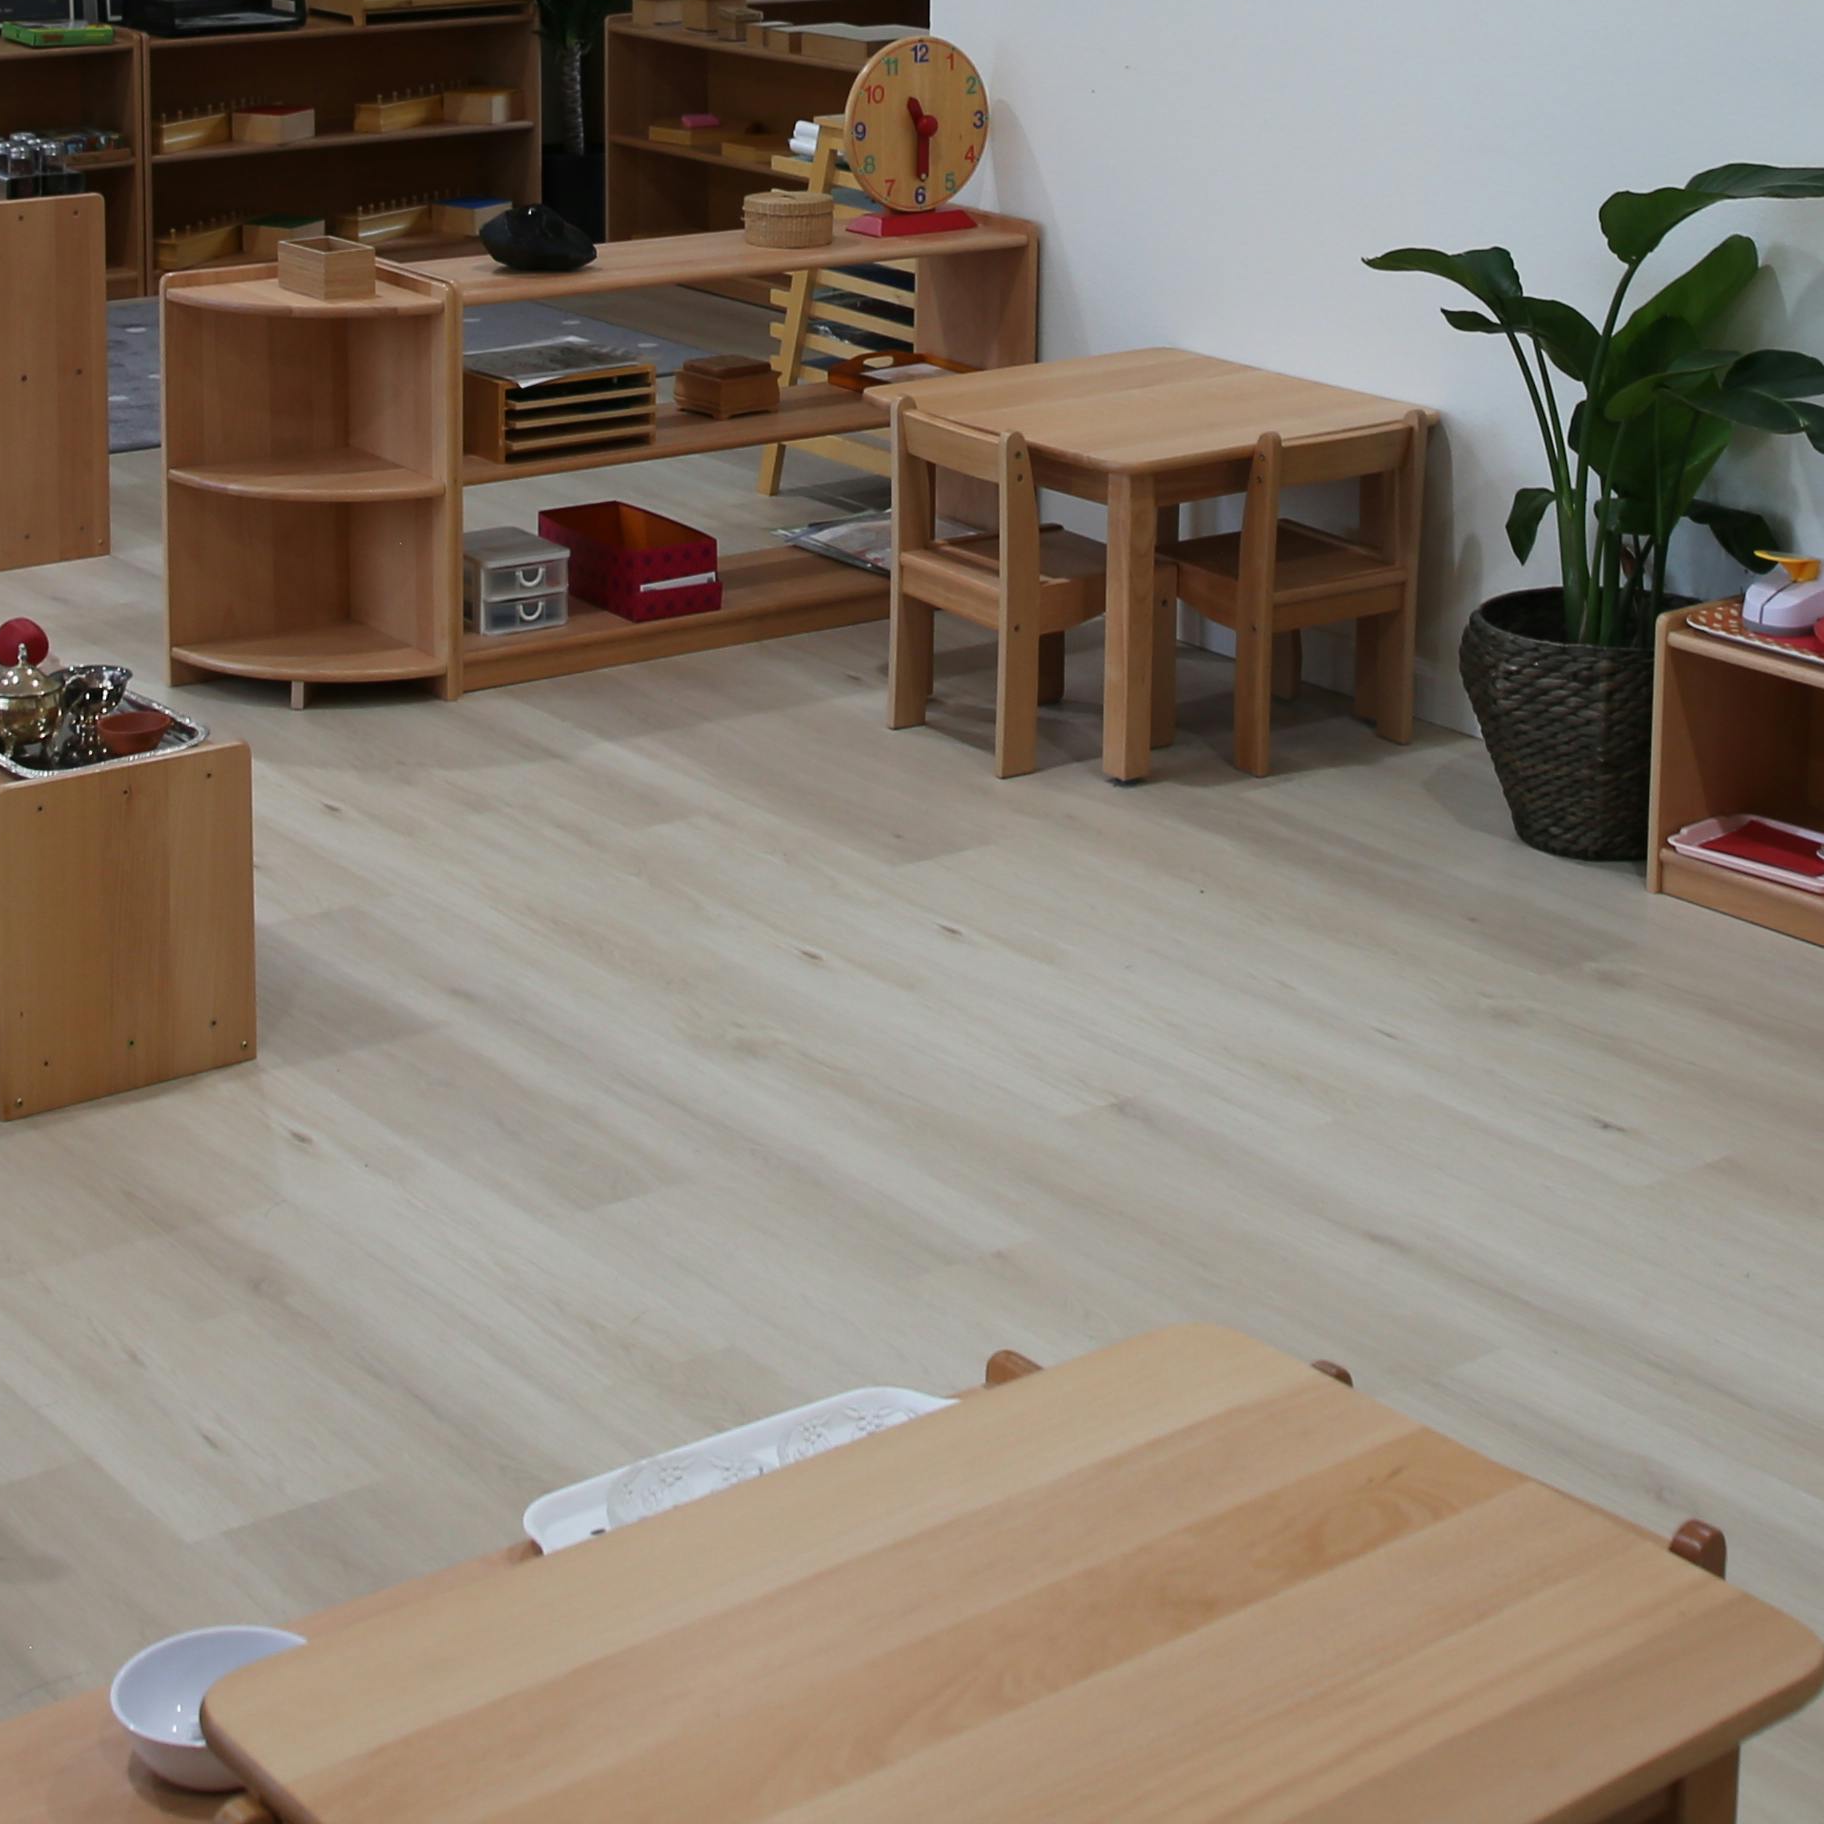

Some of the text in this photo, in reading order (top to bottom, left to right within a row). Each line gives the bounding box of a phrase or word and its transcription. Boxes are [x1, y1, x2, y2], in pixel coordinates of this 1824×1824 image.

[910, 44, 930, 64] 12
[946, 53, 956, 70] 1
[883, 57, 899, 76] 11
[864, 85, 885, 104] 10
[965, 75, 977, 95] 2
[972, 111, 985, 129] 3
[853, 122, 867, 141] 9
[964, 145, 976, 163] 4
[863, 155, 876, 174] 8
[884, 178, 896, 197] 7
[944, 172, 956, 192] 5
[914, 185, 927, 205] 6
